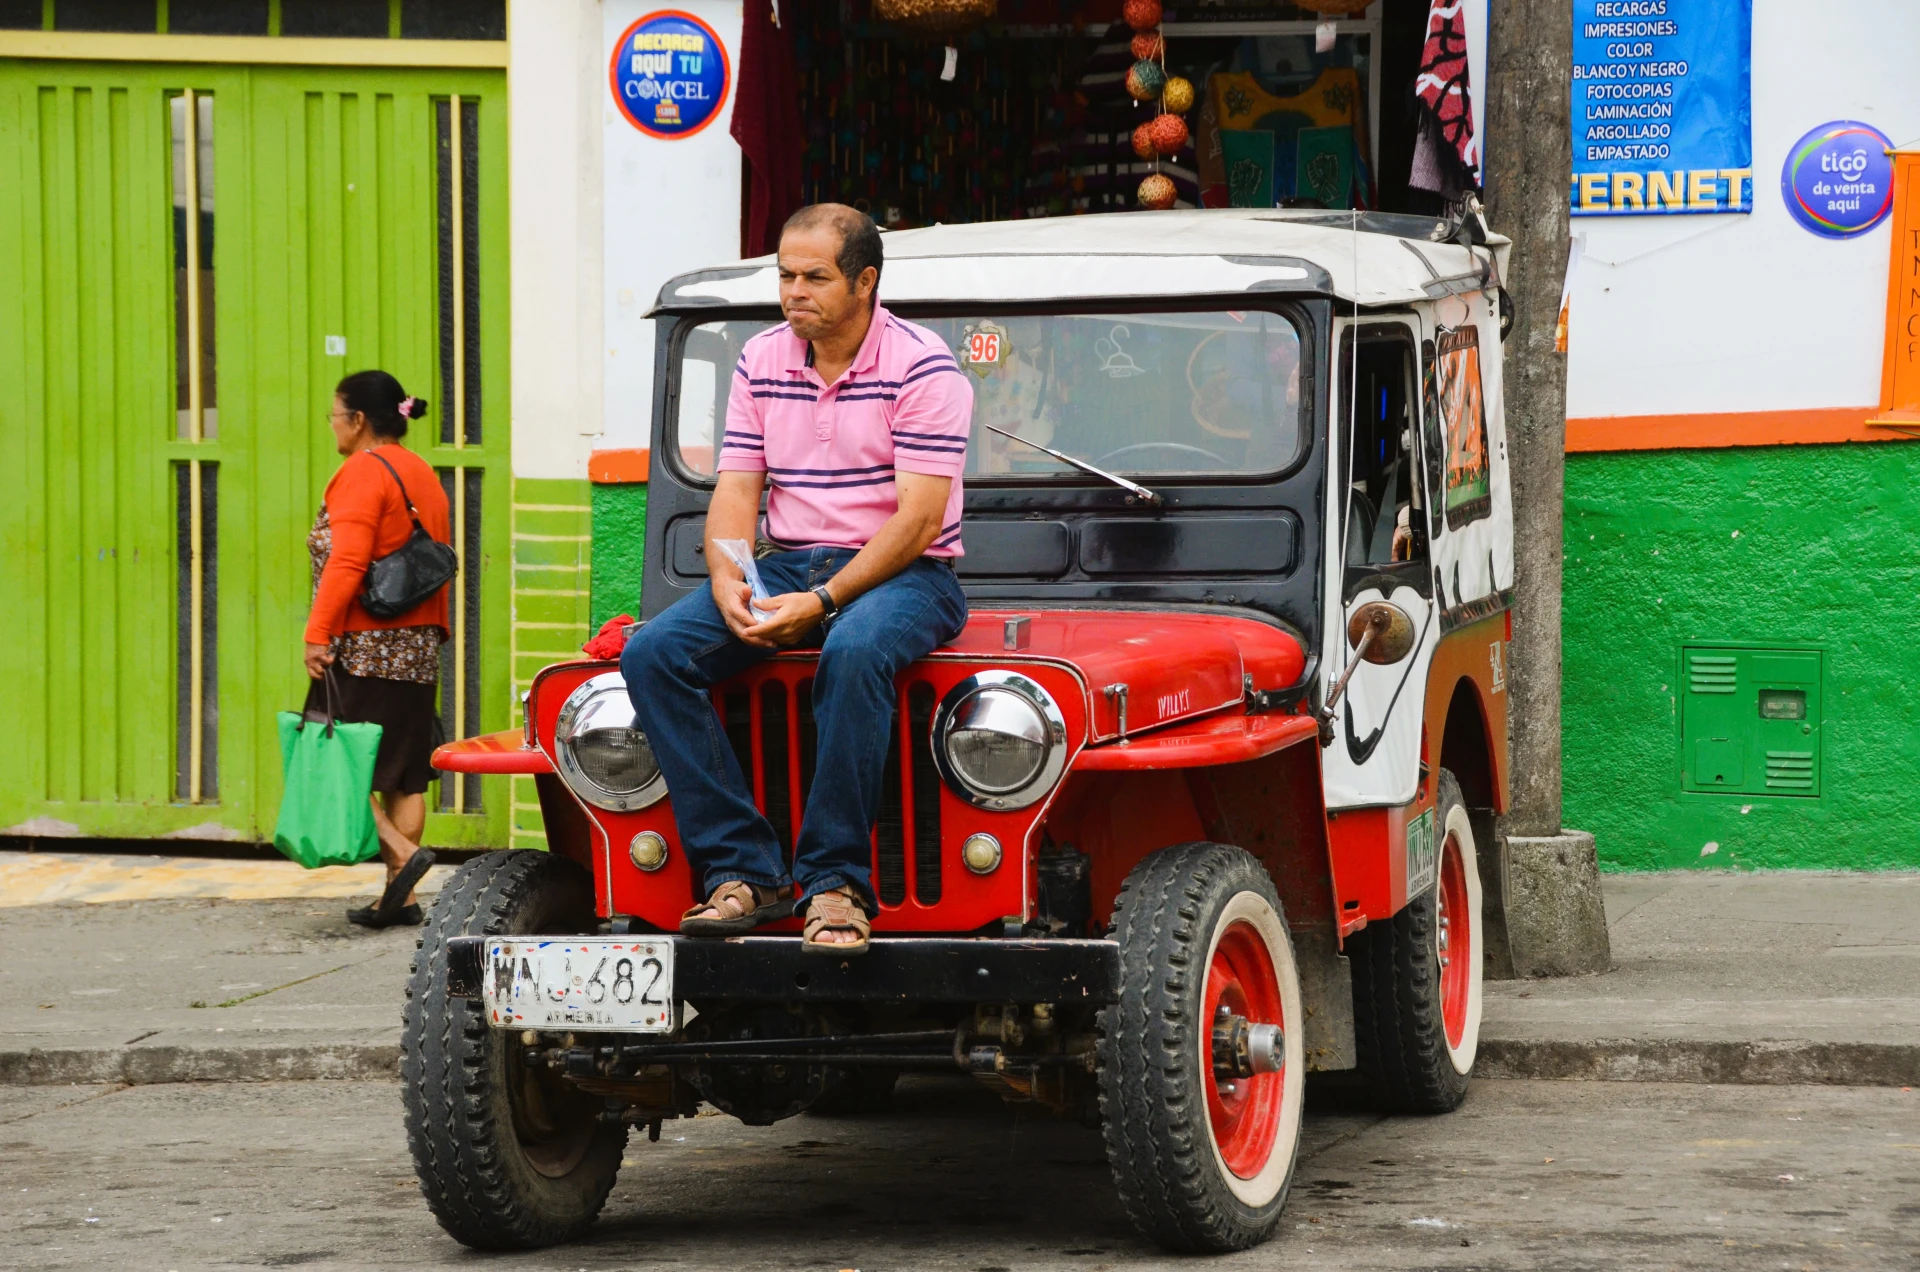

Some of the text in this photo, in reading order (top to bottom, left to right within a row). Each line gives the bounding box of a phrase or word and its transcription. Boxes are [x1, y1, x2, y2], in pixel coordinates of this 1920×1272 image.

[1596, 1, 1666, 17] RECARGAS
[1584, 21, 1677, 38] IMPRESIONES:
[633, 33, 704, 52] RECARGA
[1607, 43, 1653, 58] COLOR
[679, 55, 703, 74] TU
[1573, 61, 1688, 79] BLANCO Y NEGRO
[625, 78, 710, 100] COMCEL
[1587, 83, 1672, 99] FOTOCOPIAS
[1586, 101, 1672, 120] LAMINACIÓN
[1586, 124, 1671, 140] ARGOLLADO
[1587, 144, 1669, 160] EMPASTADO
[1813, 181, 1875, 195] de venta
[1827, 196, 1860, 214] aquí
[971, 334, 997, 361] 96
[586, 956, 665, 1006] 682
[545, 1009, 613, 1025] ARMENIA
